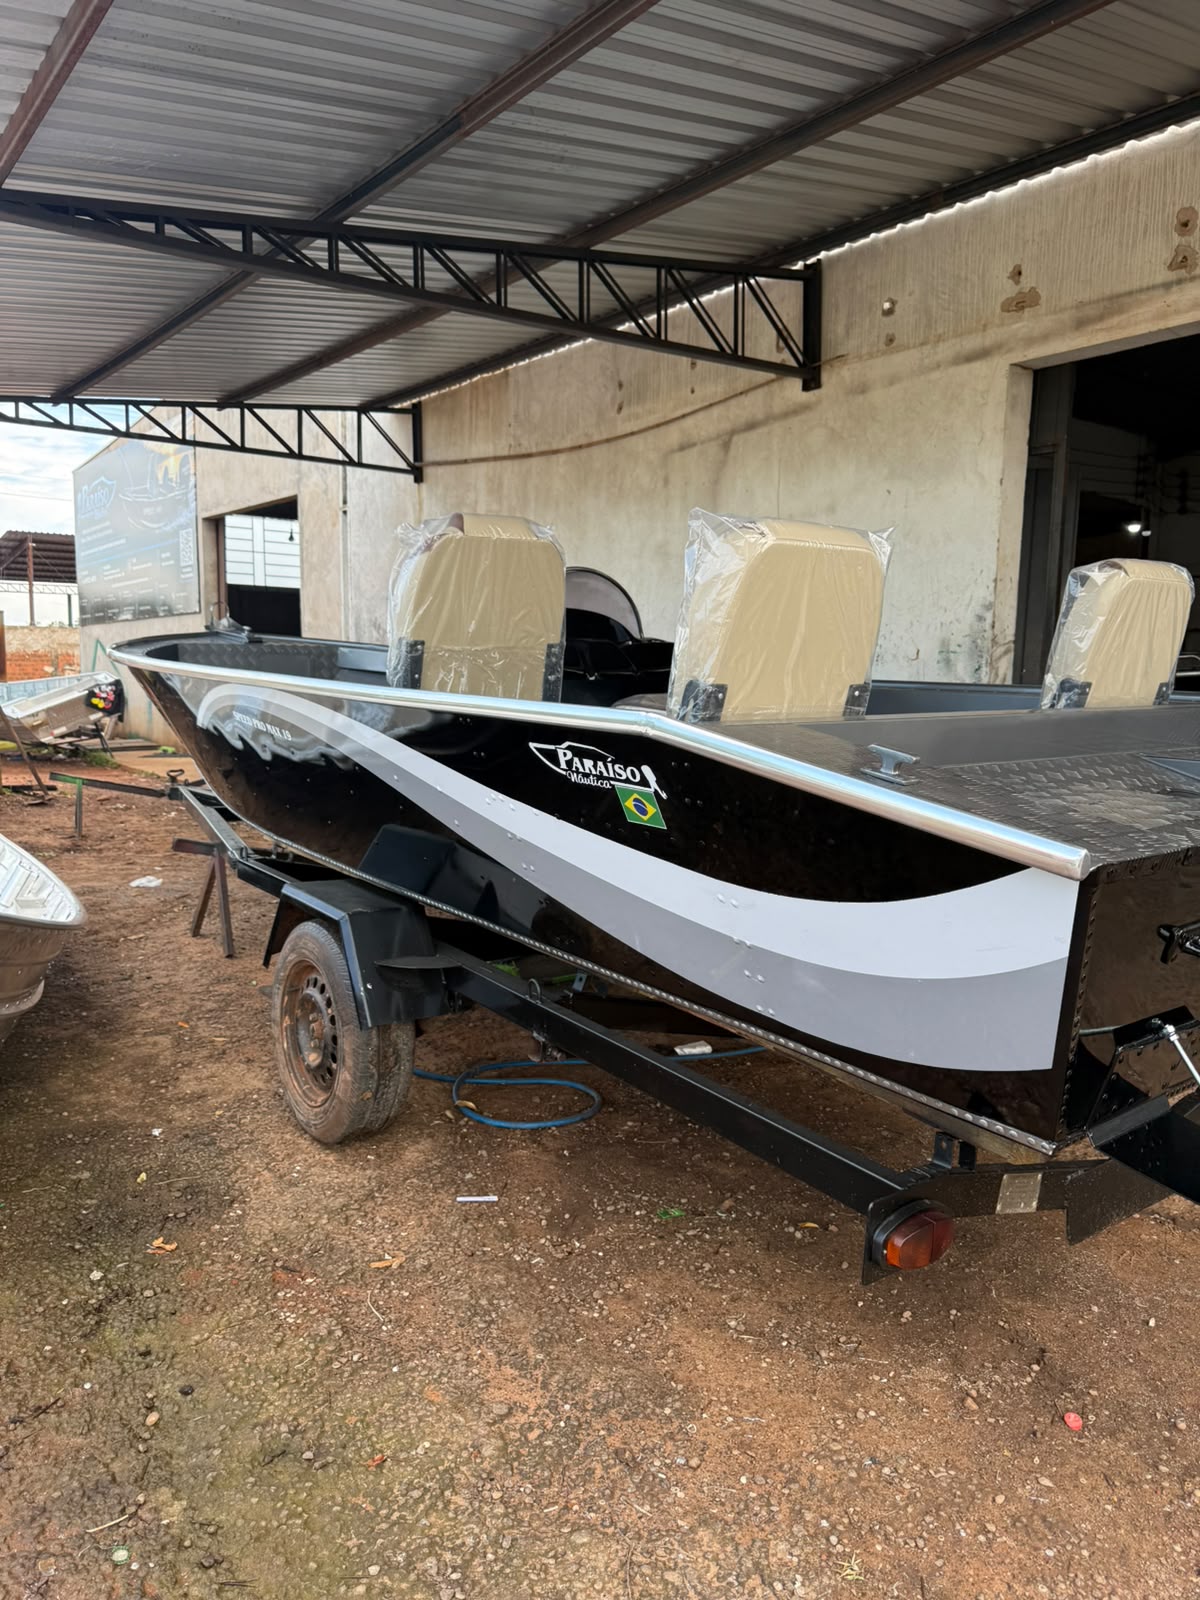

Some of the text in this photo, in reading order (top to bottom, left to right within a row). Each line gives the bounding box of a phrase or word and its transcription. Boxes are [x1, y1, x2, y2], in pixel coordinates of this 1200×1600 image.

[232, 711, 292, 741] SPEED PRO MAX 19
[557, 748, 641, 782] PARAÍSO
[567, 771, 612, 788] Náutica
